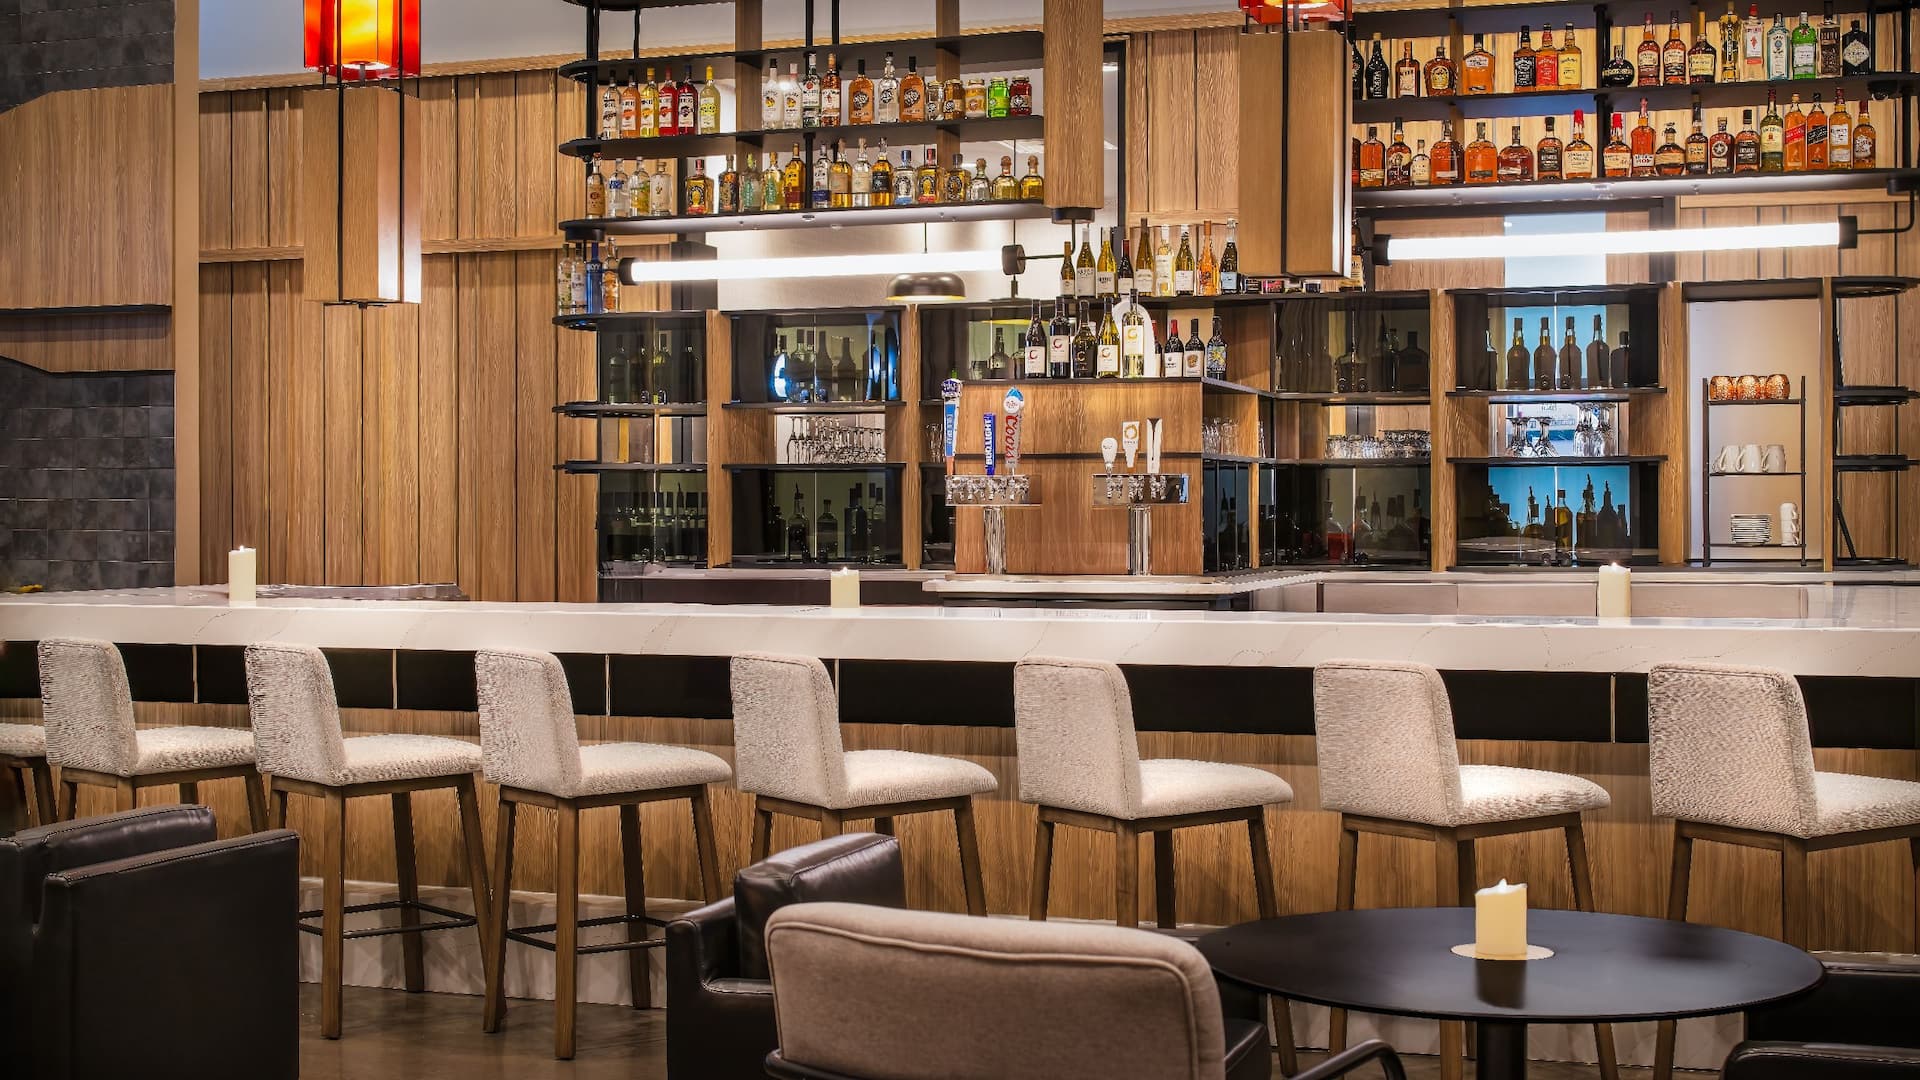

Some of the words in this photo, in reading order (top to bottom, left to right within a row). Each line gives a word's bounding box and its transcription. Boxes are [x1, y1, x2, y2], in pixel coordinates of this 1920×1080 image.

[984, 418, 993, 445] LIGHT
[1005, 415, 1018, 459] Coors
[985, 447, 993, 466] BUD
